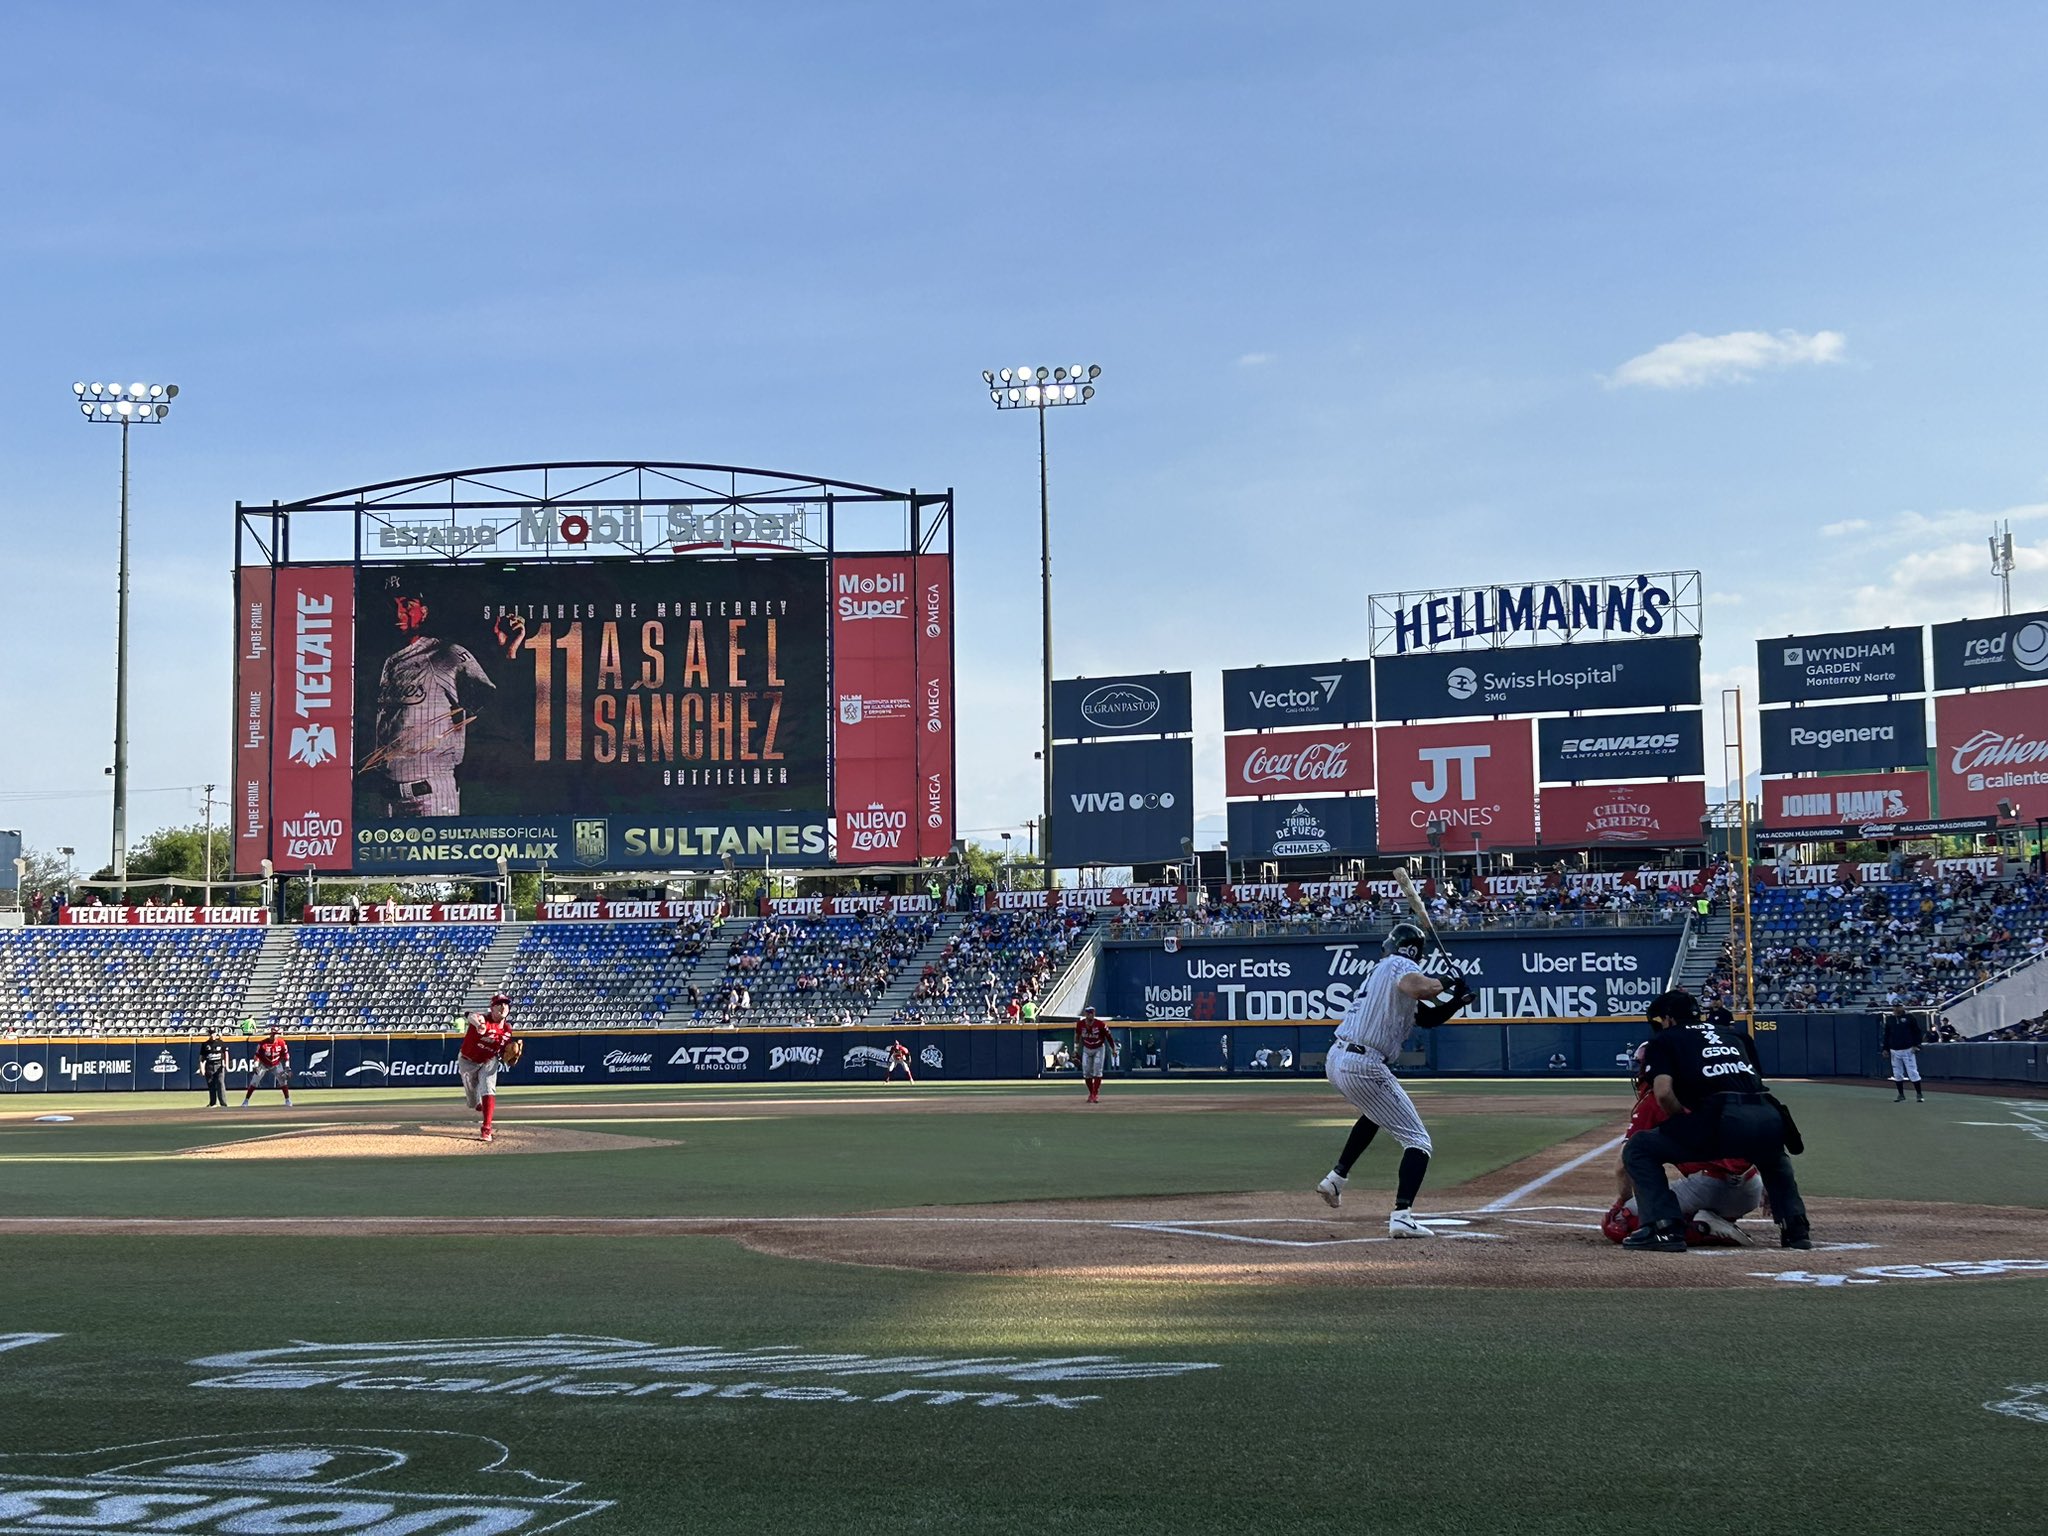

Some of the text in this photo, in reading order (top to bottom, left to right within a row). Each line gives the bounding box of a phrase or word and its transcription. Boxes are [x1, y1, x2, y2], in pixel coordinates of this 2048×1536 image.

[380, 503, 798, 551] ESTADIO Mobil Super
[838, 572, 904, 594] Mobil
[838, 596, 905, 619] Super
[927, 584, 940, 623] MEGA
[250, 602, 262, 629] PRIME
[1394, 575, 1670, 654] HELLMANN'S
[1806, 642, 1895, 661] WYNDHAM
[1964, 631, 2008, 657] red
[295, 591, 333, 719] TECATE
[598, 619, 785, 690] ASAEL
[1806, 662, 1861, 675] GARDEN
[1483, 672, 1536, 691] Swiss
[1806, 672, 1896, 687] Monterrey Norte
[524, 621, 583, 762] 11
[927, 678, 940, 718] MEGA
[1249, 688, 1319, 709] Vector
[1484, 692, 1507, 702] SMG
[250, 691, 262, 719] PRIME
[1094, 703, 1121, 713] GRAN
[1121, 701, 1156, 712] PASTOR
[594, 680, 785, 764] SÁNCHEZ
[1578, 733, 1680, 752] CAVAZOS
[1790, 725, 1894, 749] Regenera
[1242, 742, 1352, 784] Coca-Cola
[1411, 744, 1491, 803] JT
[248, 780, 259, 808] PRIME
[928, 773, 941, 813] MEGA
[1781, 789, 1903, 817] JOHN HAM'S
[1593, 803, 1651, 817] CHINO
[575, 821, 605, 838] 85
[1285, 817, 1317, 827] TRIBUS
[1585, 816, 1660, 832] ARRIETA
[624, 825, 826, 857] SULTANES
[1275, 826, 1326, 839] DE FUEGO
[358, 842, 559, 864] SULTANES.COM.MX
[995, 890, 1050, 909] TECATE
[1058, 888, 1113, 906] TECATE
[1367, 879, 1427, 898] TECAE
[67, 906, 261, 924] TECATE TECATE TECATE
[310, 903, 498, 922] TECAE TCATE TECATE
[544, 901, 600, 918] TECATE
[605, 900, 661, 917] TECATE
[768, 897, 824, 915] TECATE
[889, 895, 932, 912] TECAT
[1187, 959, 1292, 979] Uber Eats
[1325, 945, 1375, 977] Tim
[1521, 951, 1638, 973] Uber Eats
[1144, 984, 1192, 1002] Mobil
[1605, 976, 1662, 996] Mobil
[1145, 1003, 1192, 1020] Super
[1606, 997, 1651, 1016] Supe
[1754, 1021, 1777, 1031] 325
[602, 1049, 653, 1066] Caliente
[668, 1046, 750, 1065] ATRO
[83, 1059, 132, 1075] BE PRIME
[390, 1060, 459, 1076] Electroli
[534, 1065, 586, 1074] MONTERREY
